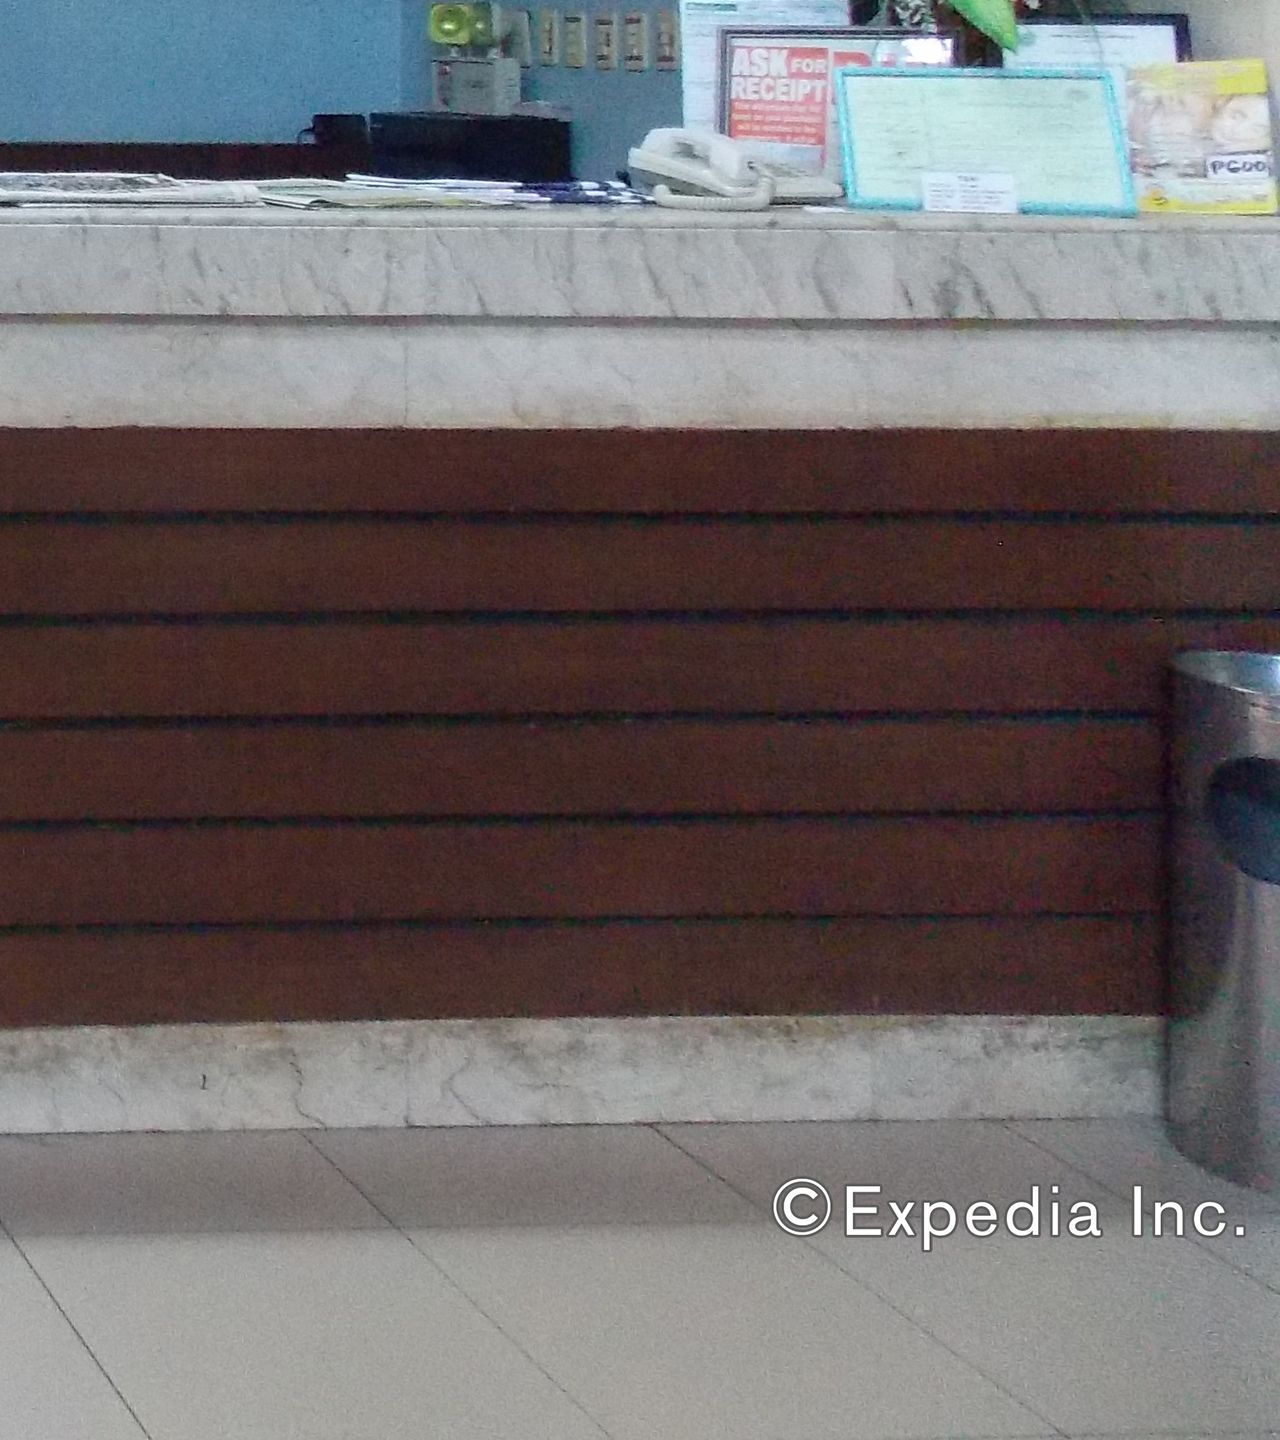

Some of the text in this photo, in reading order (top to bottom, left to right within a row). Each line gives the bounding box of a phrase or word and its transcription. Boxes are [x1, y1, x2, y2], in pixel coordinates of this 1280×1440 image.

[733, 48, 788, 77] ASK
[791, 58, 827, 74] FOR
[731, 78, 827, 102] RECEIPT
